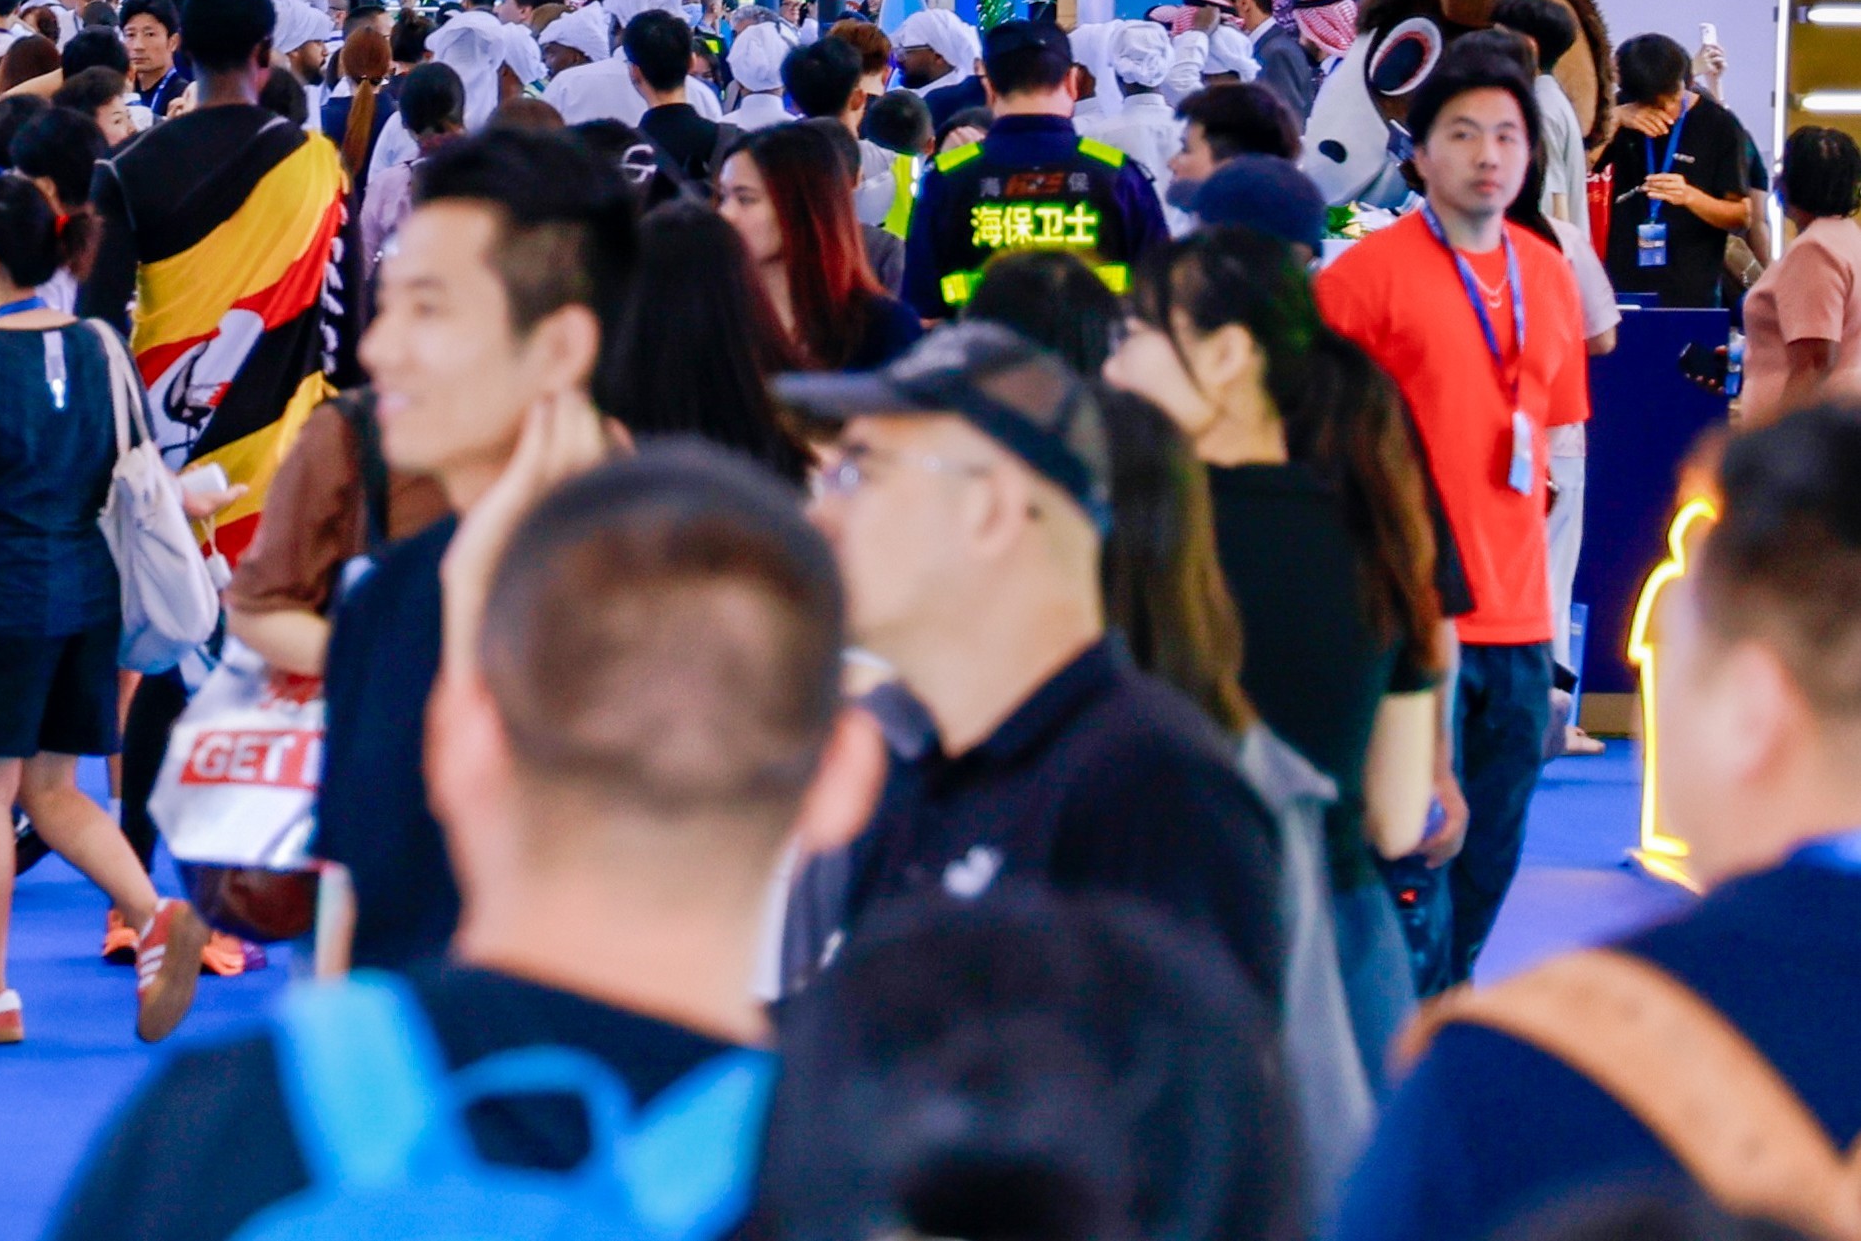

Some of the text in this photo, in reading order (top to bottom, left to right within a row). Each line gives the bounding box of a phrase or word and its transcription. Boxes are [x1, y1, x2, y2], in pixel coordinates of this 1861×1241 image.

[970, 203, 1097, 247] 海保卫士
[192, 733, 297, 783] GET
